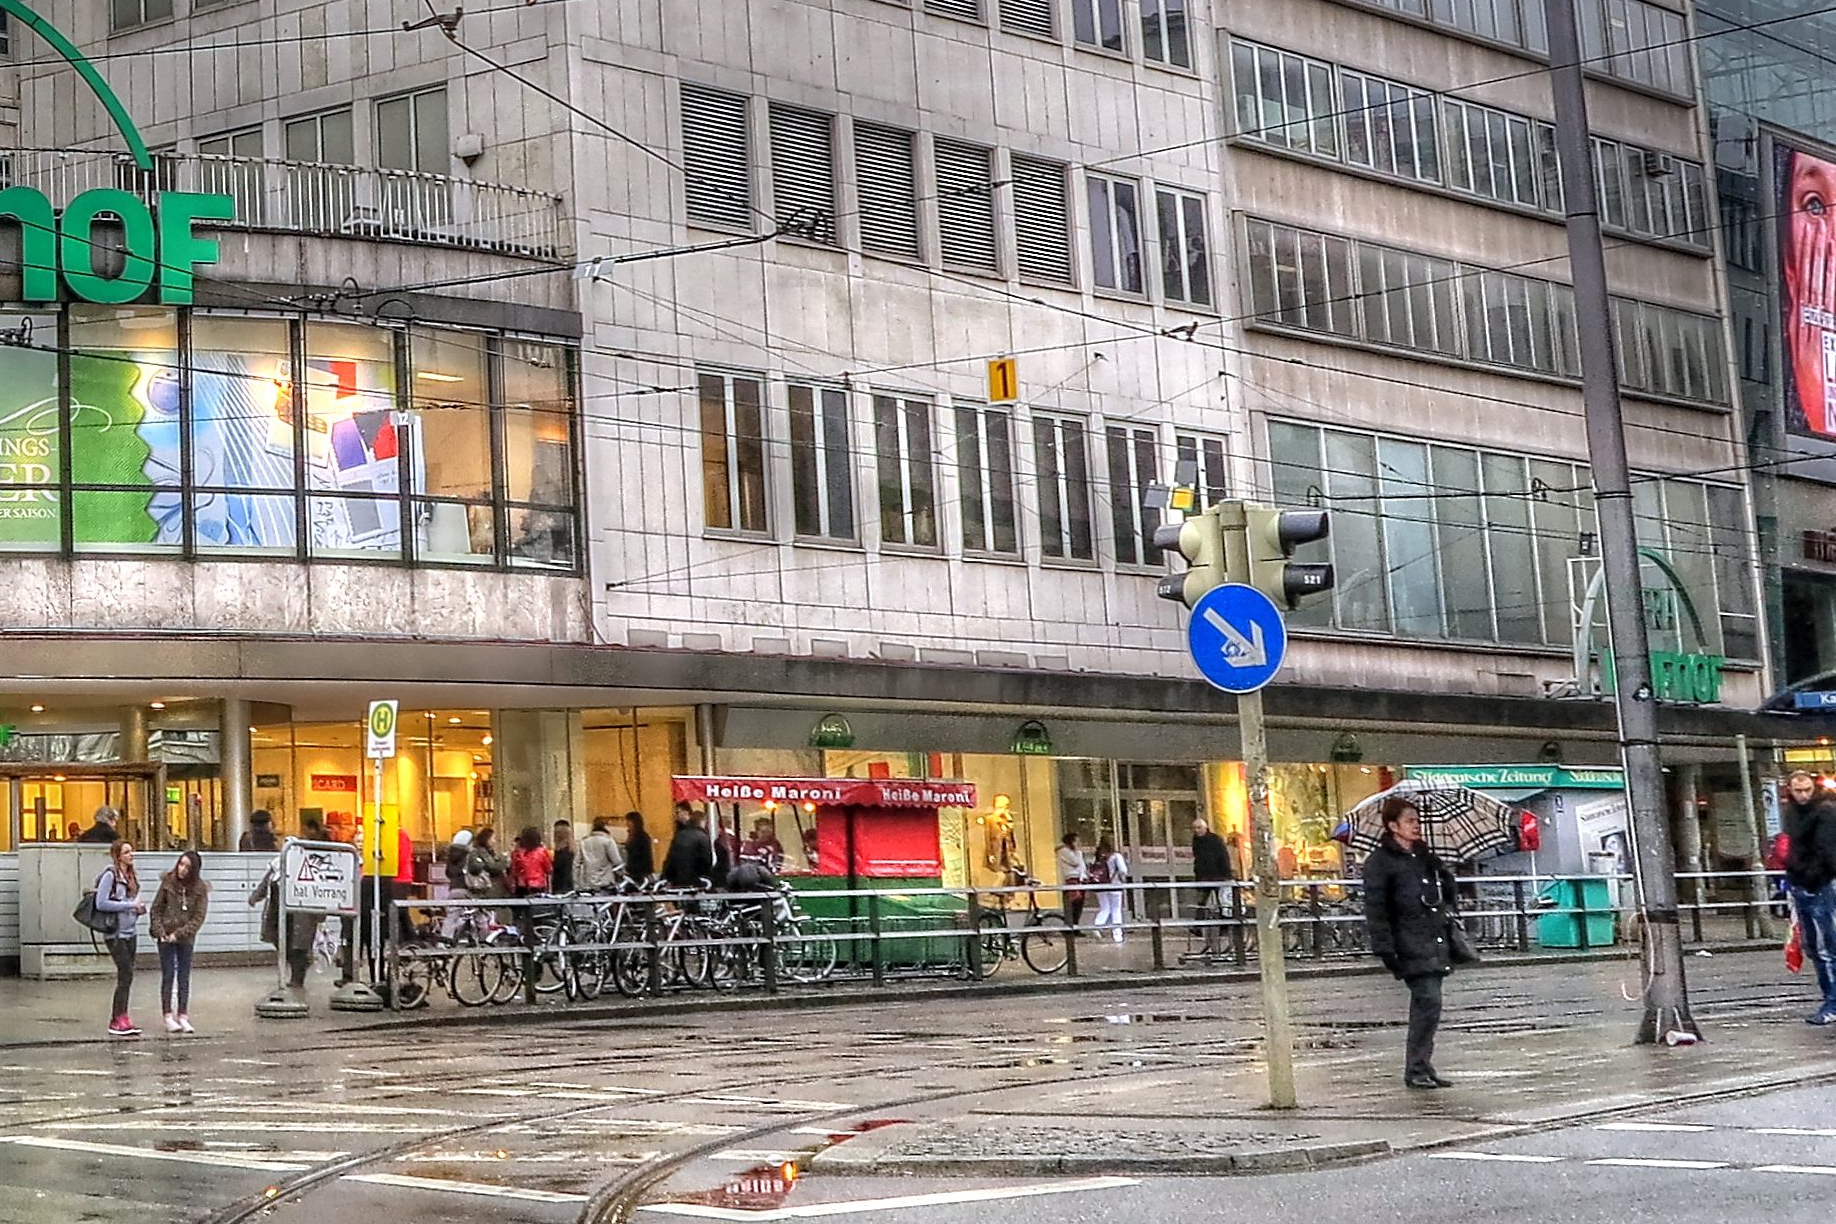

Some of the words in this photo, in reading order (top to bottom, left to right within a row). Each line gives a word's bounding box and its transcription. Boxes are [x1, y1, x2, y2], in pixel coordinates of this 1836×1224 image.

[996, 362, 1009, 398] 1
[1498, 768, 1554, 786] Zeitung
[706, 783, 764, 800] Heiße
[771, 785, 842, 800] Maroni
[882, 787, 920, 803] Heiße
[922, 789, 971, 805] Maroni
[293, 886, 308, 898] hat
[313, 886, 347, 901] Vorrang
